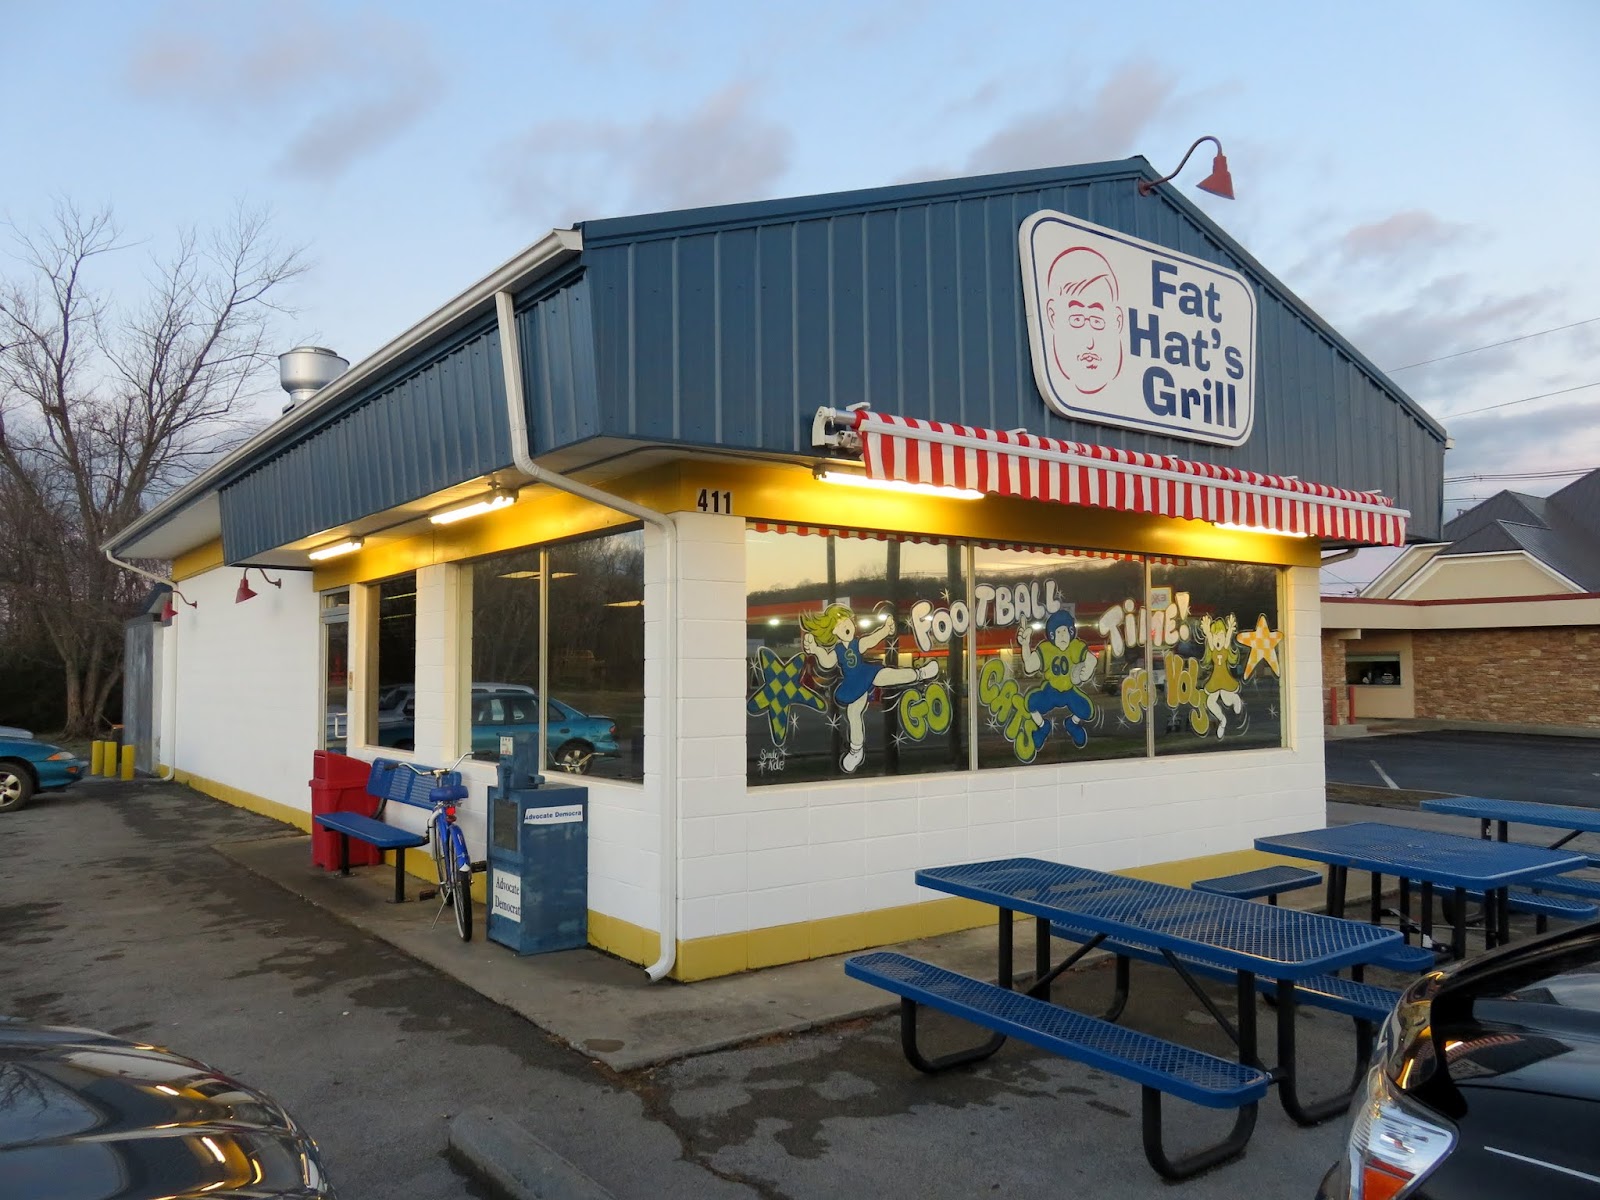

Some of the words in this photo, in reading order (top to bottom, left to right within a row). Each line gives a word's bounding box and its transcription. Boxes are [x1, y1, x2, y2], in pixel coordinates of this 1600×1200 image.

[1151, 260, 1223, 324] Fat
[1128, 307, 1244, 380] Hat's
[1142, 366, 1237, 429] Grill
[697, 488, 731, 515] 411
[844, 648, 857, 668] S
[1051, 655, 1069, 676] 60
[899, 682, 952, 741] GO
[495, 876, 520, 896] Advocate
